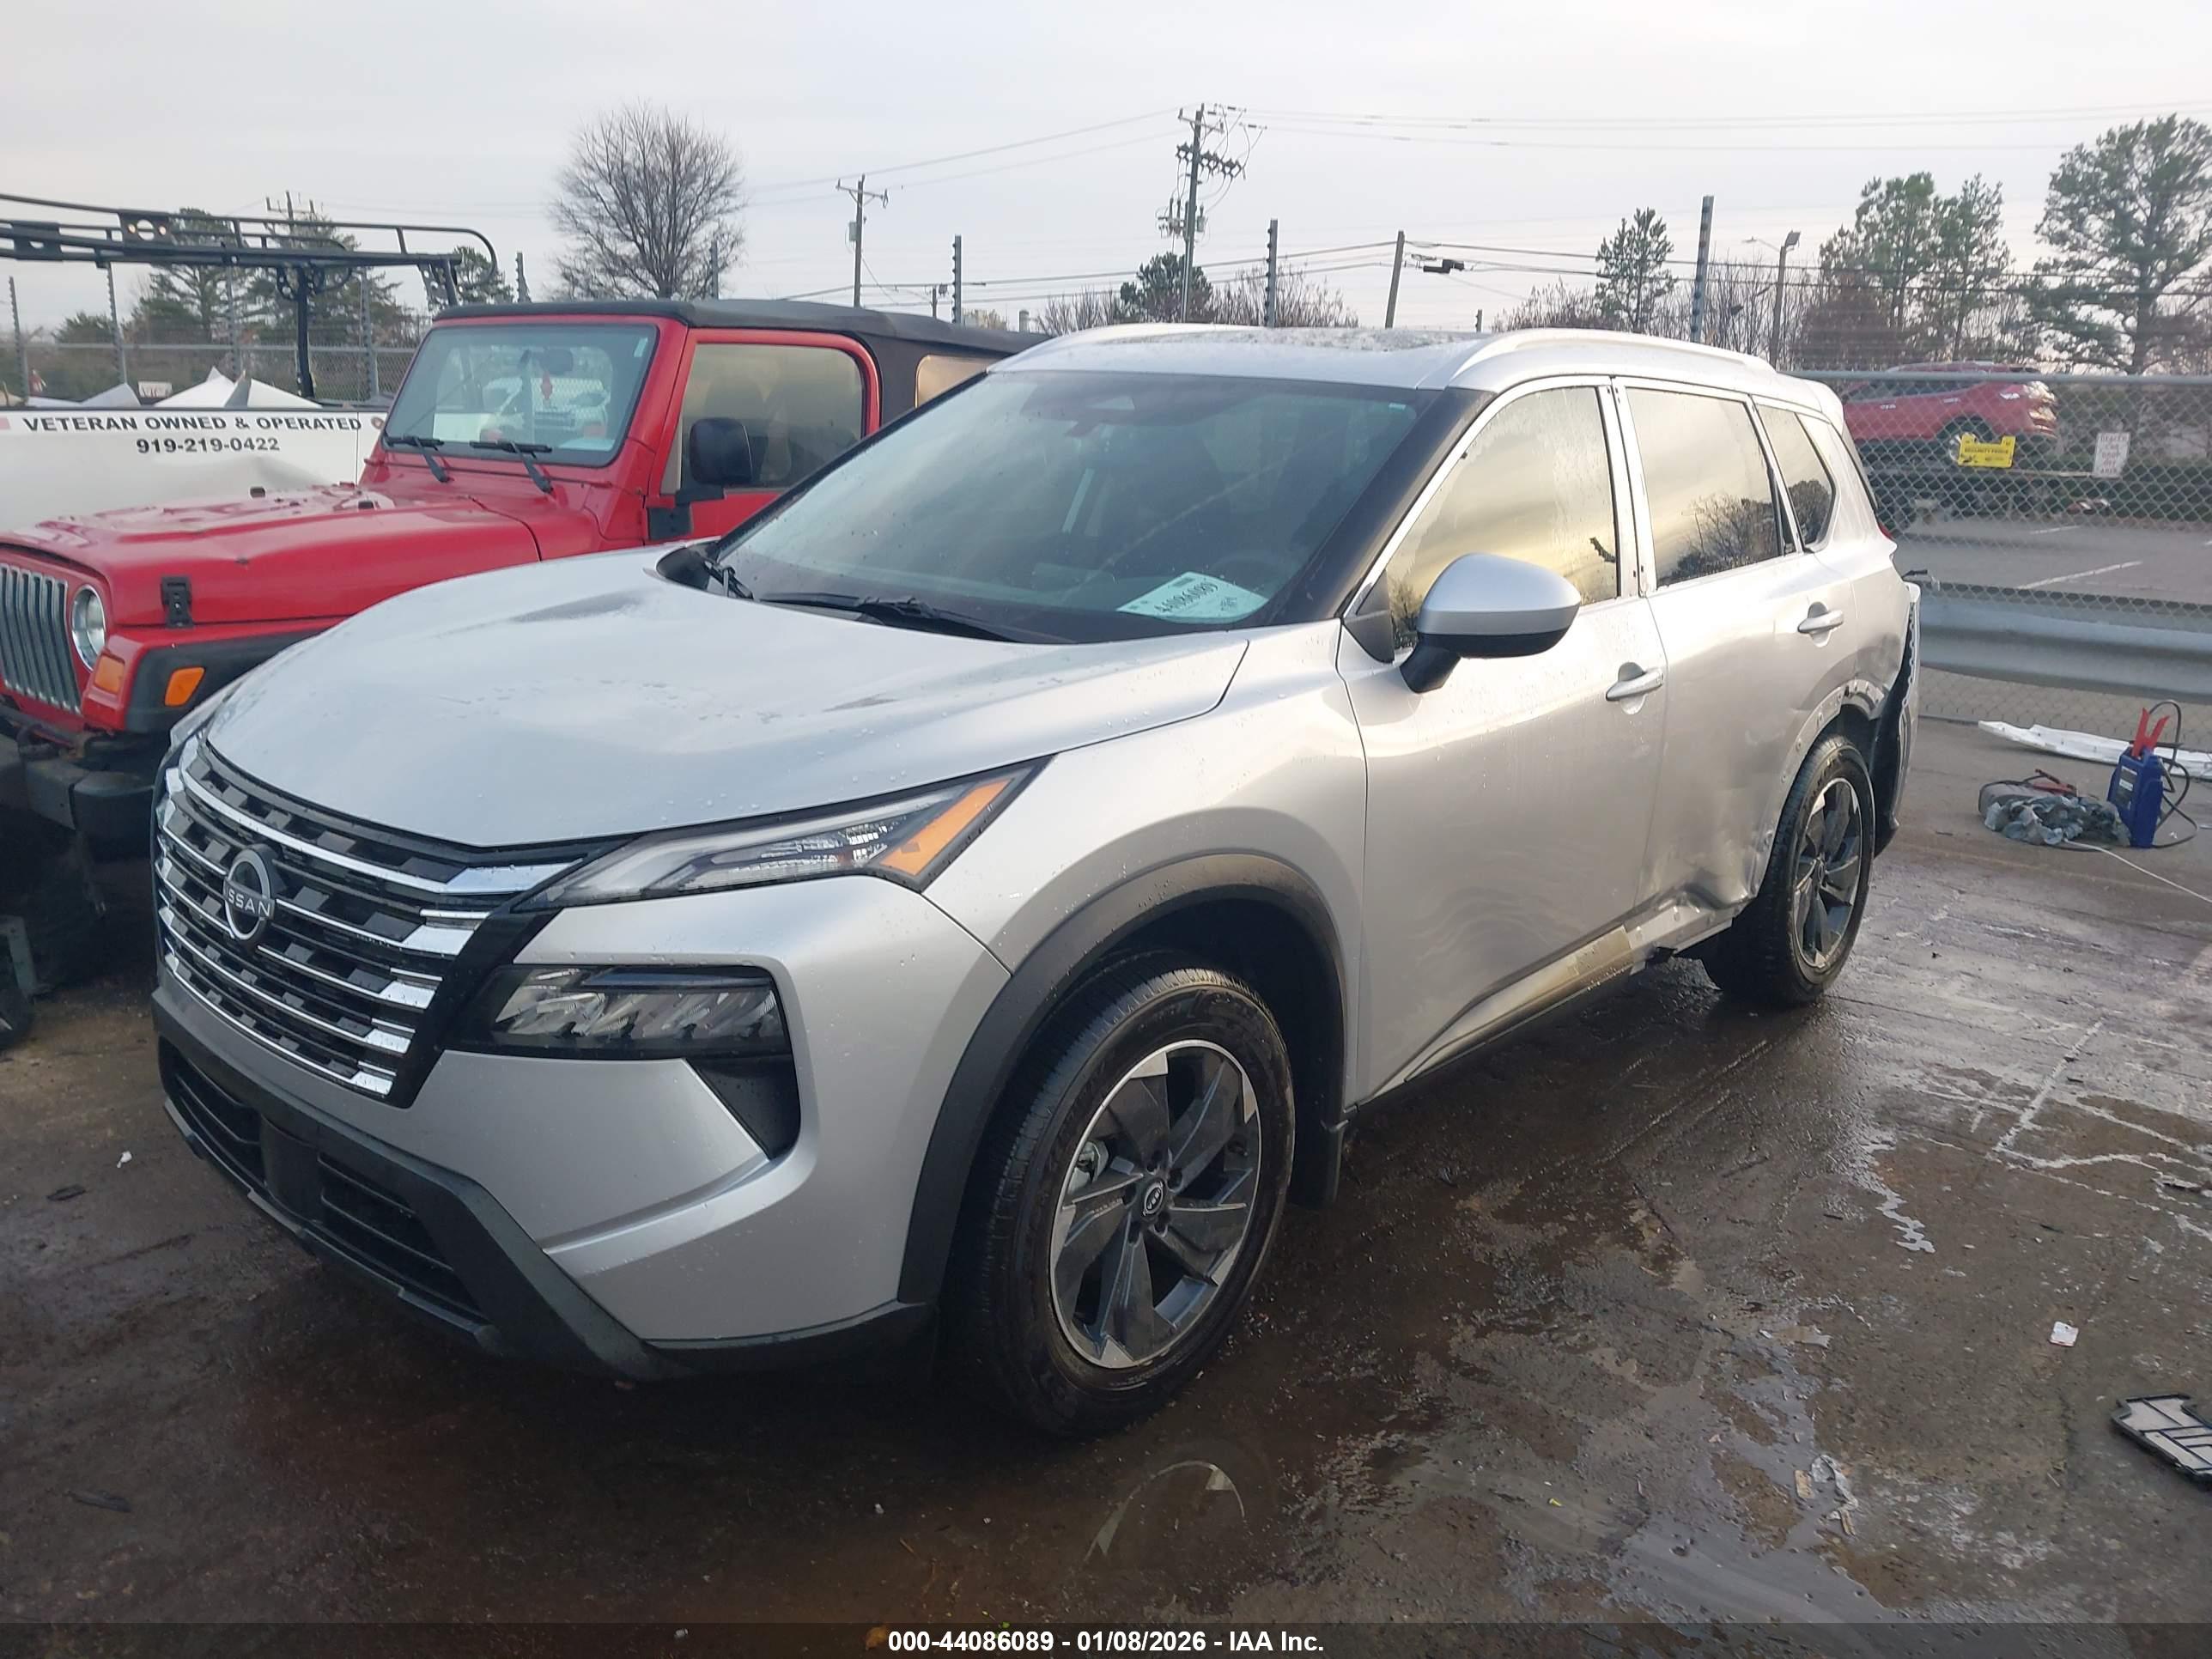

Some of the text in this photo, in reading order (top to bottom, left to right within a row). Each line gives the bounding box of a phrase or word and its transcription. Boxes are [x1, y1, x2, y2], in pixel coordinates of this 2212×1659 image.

[23, 417, 362, 432] VETERAN OWNED & OPERATED
[136, 437, 281, 454] 919-219-0422
